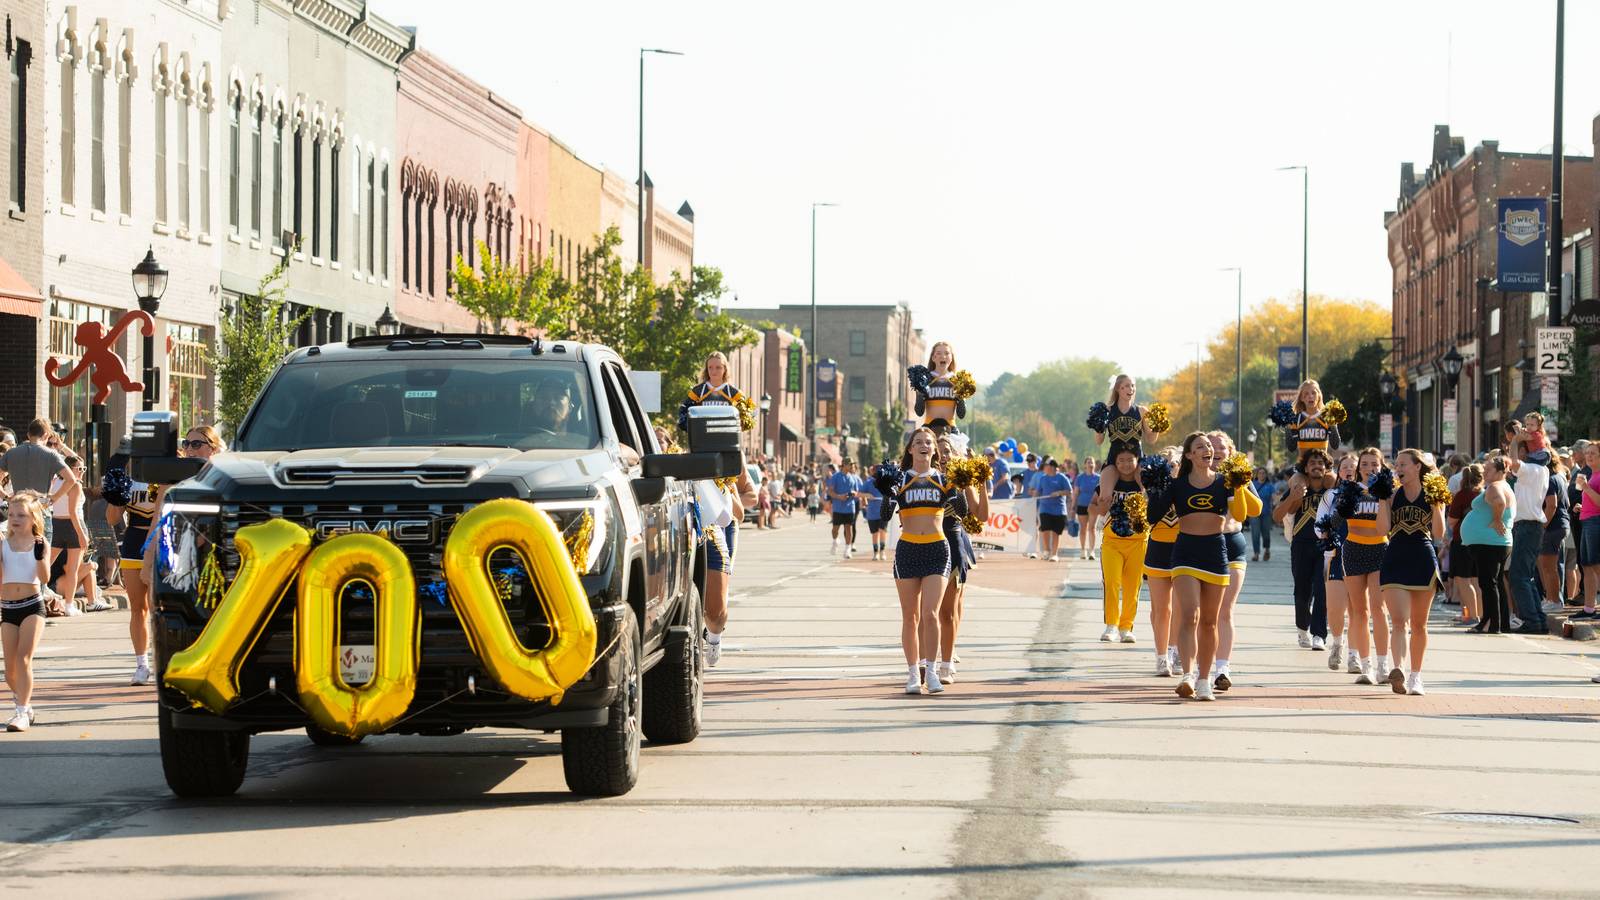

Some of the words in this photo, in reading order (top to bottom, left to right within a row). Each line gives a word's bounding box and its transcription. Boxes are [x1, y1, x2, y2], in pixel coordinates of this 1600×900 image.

[1543, 342, 1568, 350] LIMIT
[1541, 353, 1569, 369] 25
[928, 386, 956, 398] UWEC
[1299, 429, 1327, 439] UWEC
[905, 488, 940, 503] UWEC
[316, 520, 429, 540] GMC
